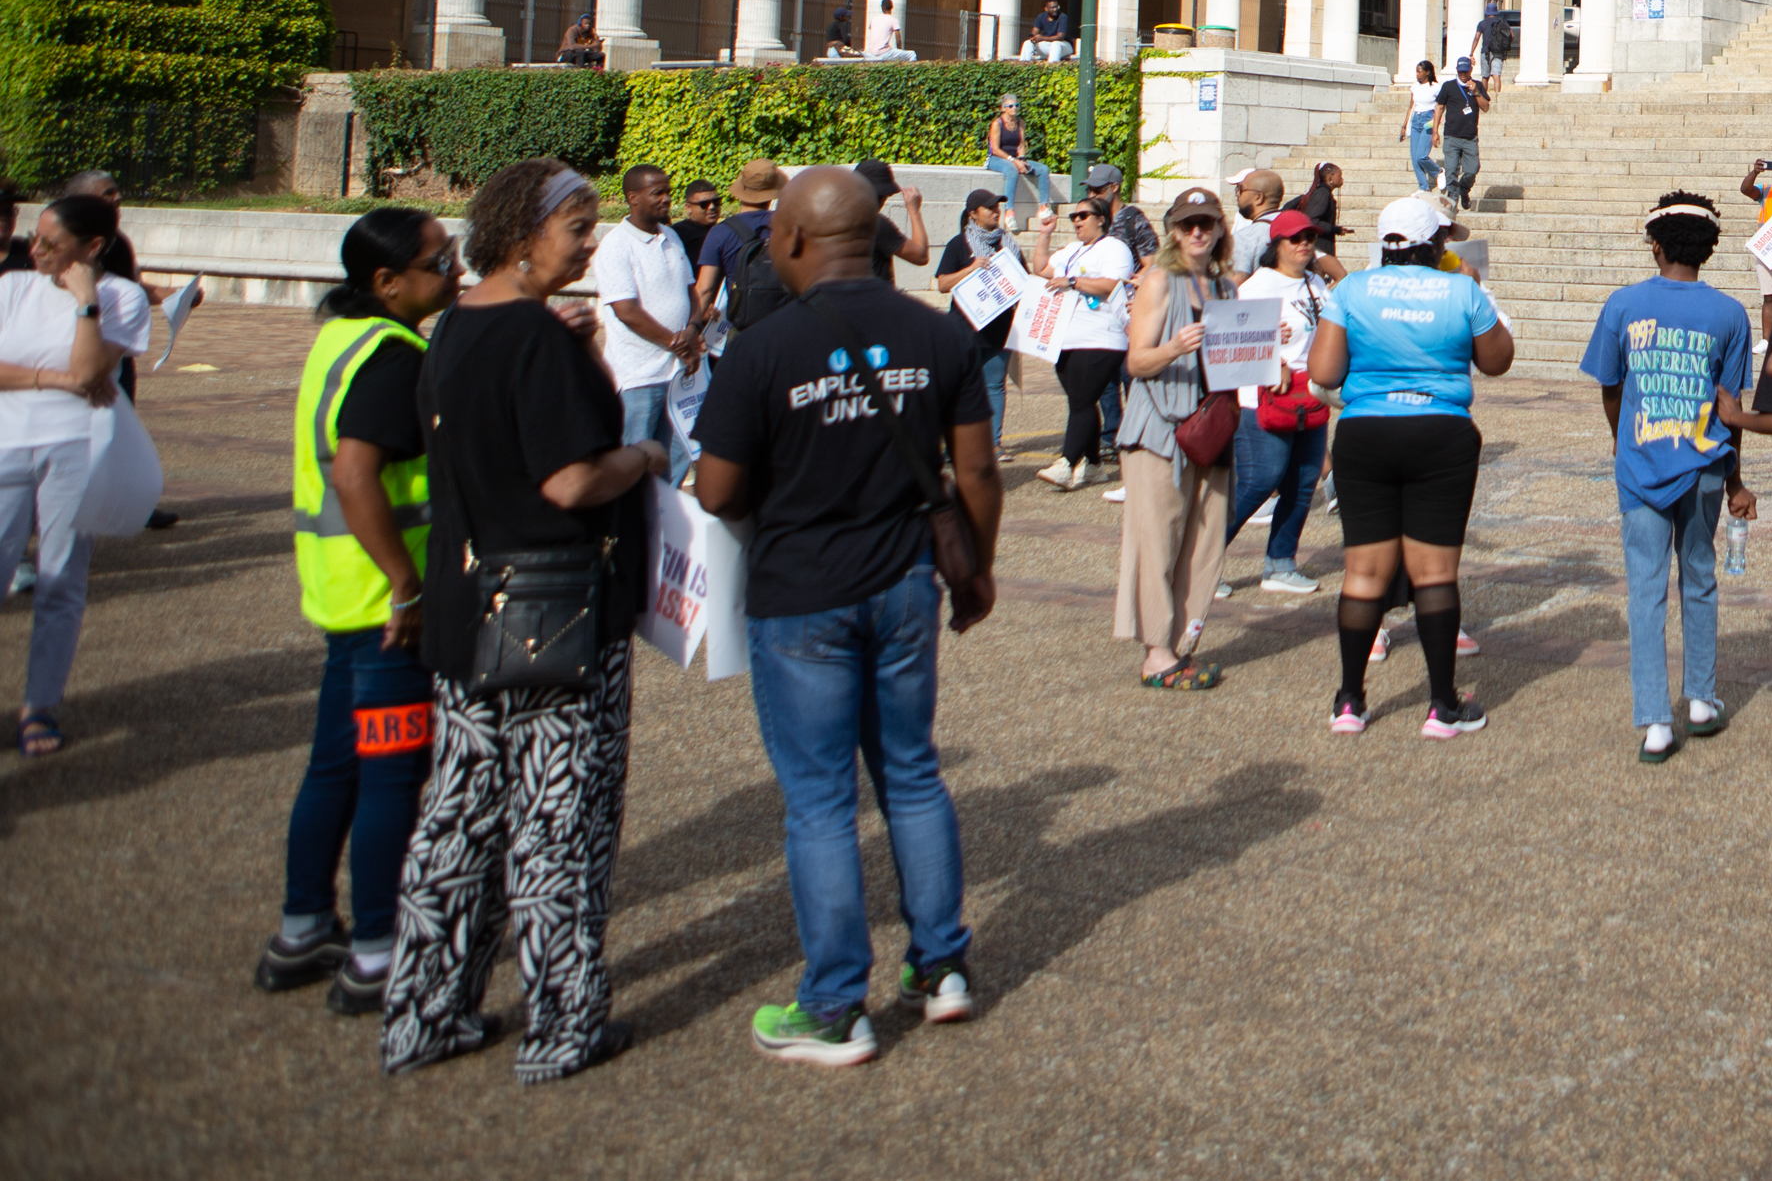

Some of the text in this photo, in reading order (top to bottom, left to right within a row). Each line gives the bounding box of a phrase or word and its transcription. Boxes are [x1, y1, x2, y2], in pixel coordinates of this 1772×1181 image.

[978, 270, 1008, 305] BULLYING
[998, 277, 1017, 296] STOP
[1367, 274, 1450, 290] CONQUER
[976, 288, 990, 302] US
[1367, 287, 1451, 300] THE CURRENT
[1028, 296, 1051, 339] UNDERPAID
[717, 320, 731, 335] UC
[1628, 318, 1657, 350] 1997
[1656, 327, 1685, 352] BIG
[1205, 329, 1276, 346] GOOD FAITH BARGAINING
[1207, 345, 1274, 365] BASIC LABOUR LAW
[1628, 350, 1711, 378] CONFERENC
[789, 368, 930, 410] EMPLOEES
[676, 394, 697, 410] MASTER
[1641, 396, 1697, 421] SEASON
